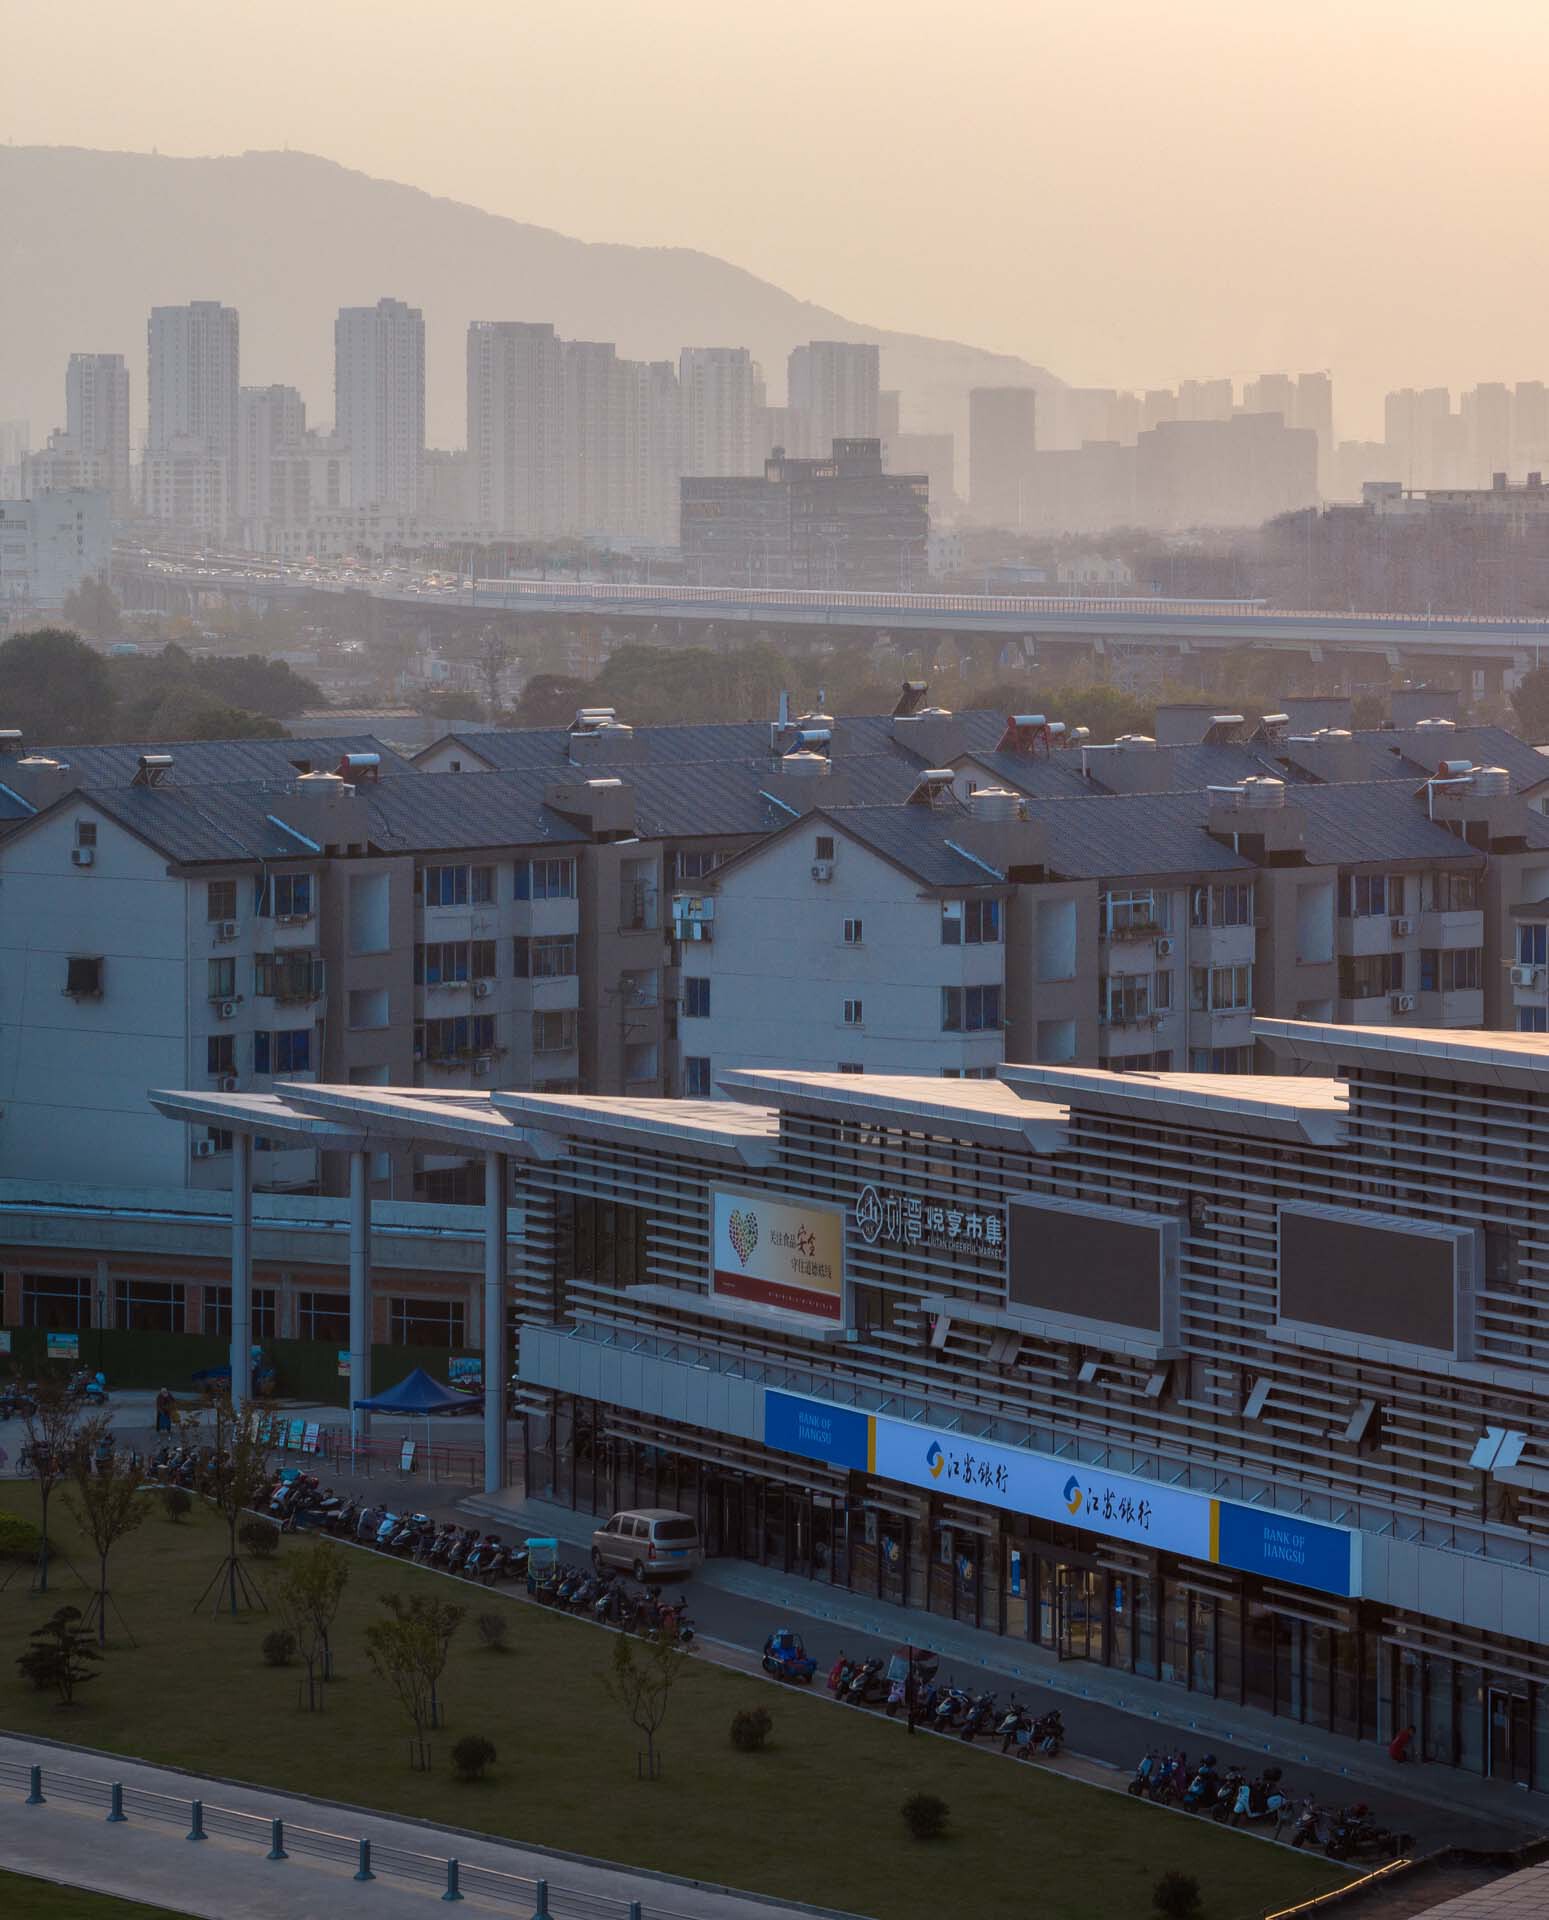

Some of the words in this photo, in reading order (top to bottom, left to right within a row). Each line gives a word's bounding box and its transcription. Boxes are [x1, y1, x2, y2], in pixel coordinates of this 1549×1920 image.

[798, 1411, 820, 1428] BANK
[821, 1417, 832, 1430] OF
[798, 1425, 832, 1445] JIANGSU
[947, 1452, 1009, 1494] 江苏银行
[1086, 1488, 1153, 1531] 江苏银行
[1264, 1527, 1290, 1545] BANK
[1292, 1535, 1305, 1550] OF
[1264, 1542, 1305, 1566] JIANGSU
